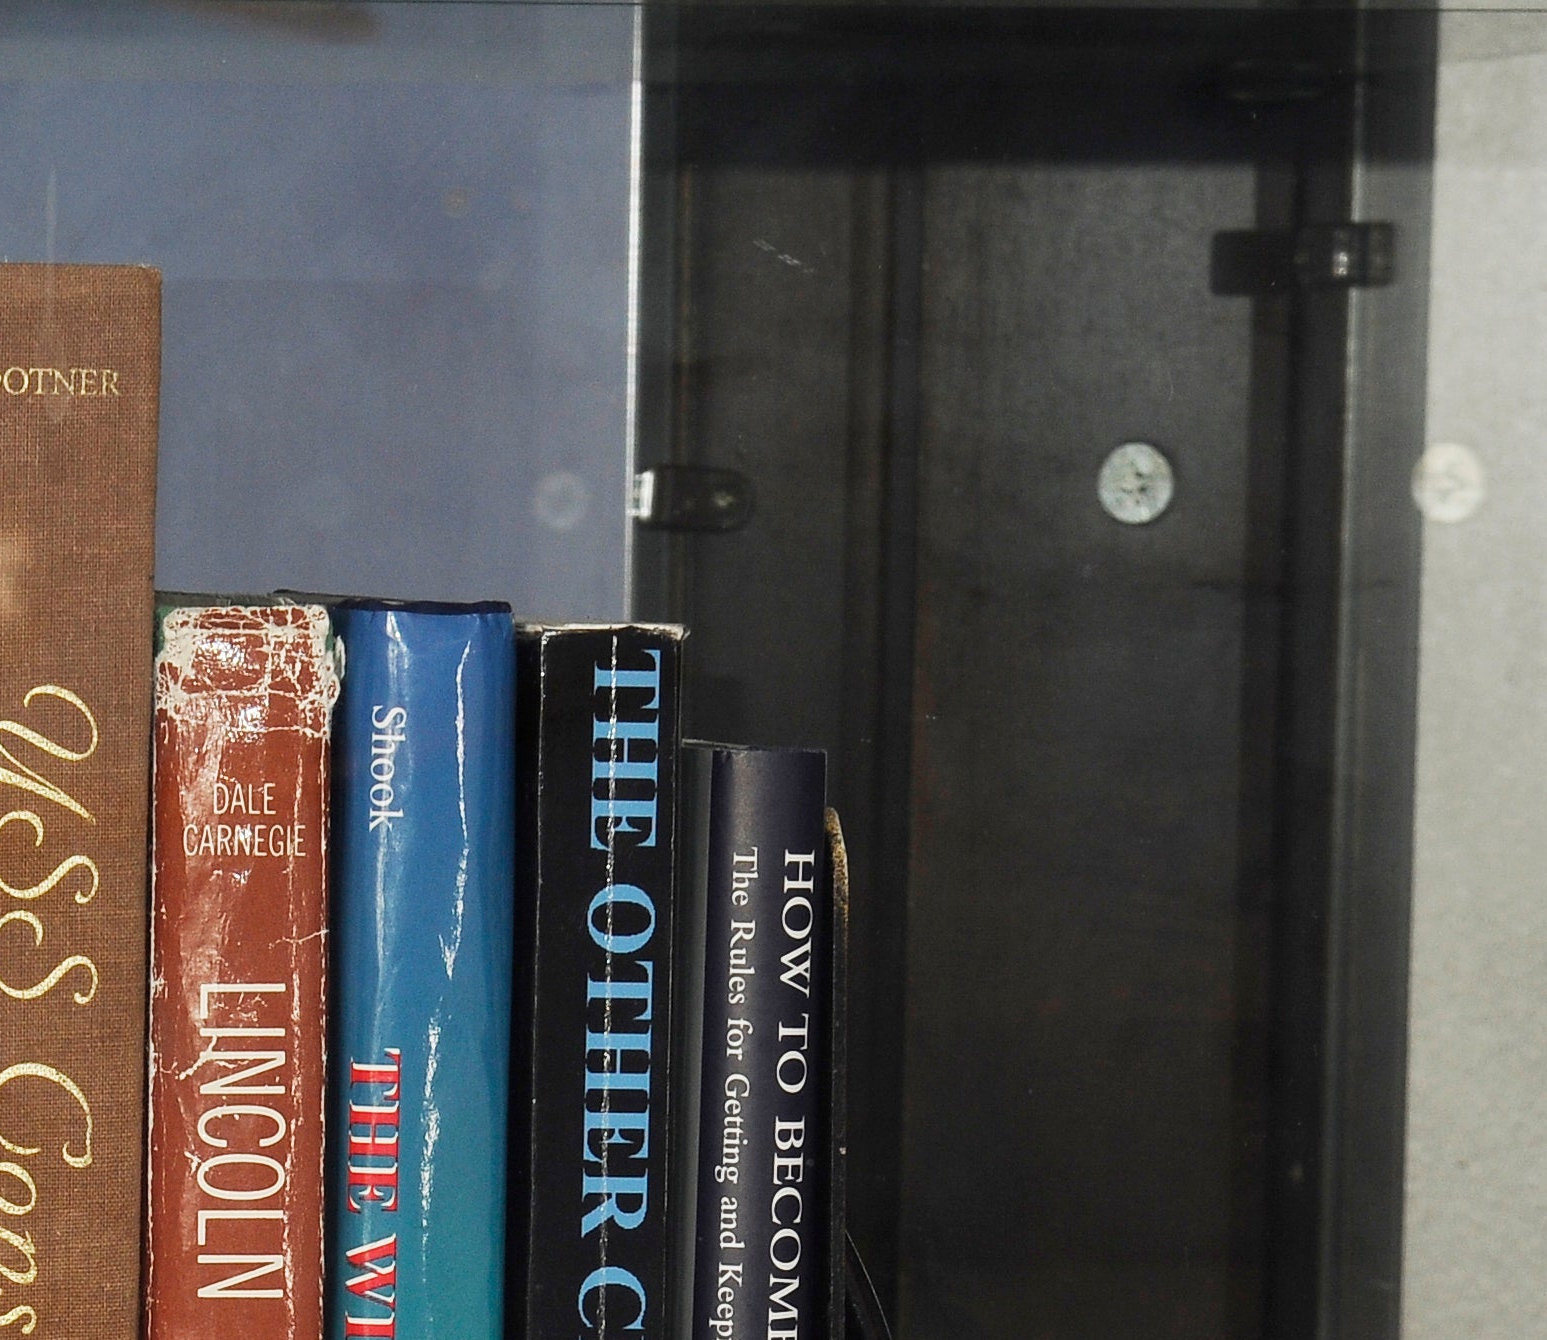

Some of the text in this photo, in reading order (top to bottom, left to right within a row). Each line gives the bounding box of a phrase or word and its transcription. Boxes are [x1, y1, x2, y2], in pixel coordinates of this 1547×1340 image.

[213, 783, 276, 815] DALE
[369, 705, 407, 832] Shook
[590, 649, 661, 852] THE
[183, 823, 307, 857] CARNEGIE
[731, 846, 758, 906] The
[728, 919, 756, 1005] Rules
[779, 848, 815, 999] HOW
[580, 883, 656, 1238] OTHER
[724, 1016, 752, 1061] for
[774, 1013, 808, 1094] TO
[196, 982, 287, 1301] LINCOLN
[347, 1047, 401, 1214] THE
[714, 1072, 750, 1184] Getting
[718, 1192, 745, 1251] and
